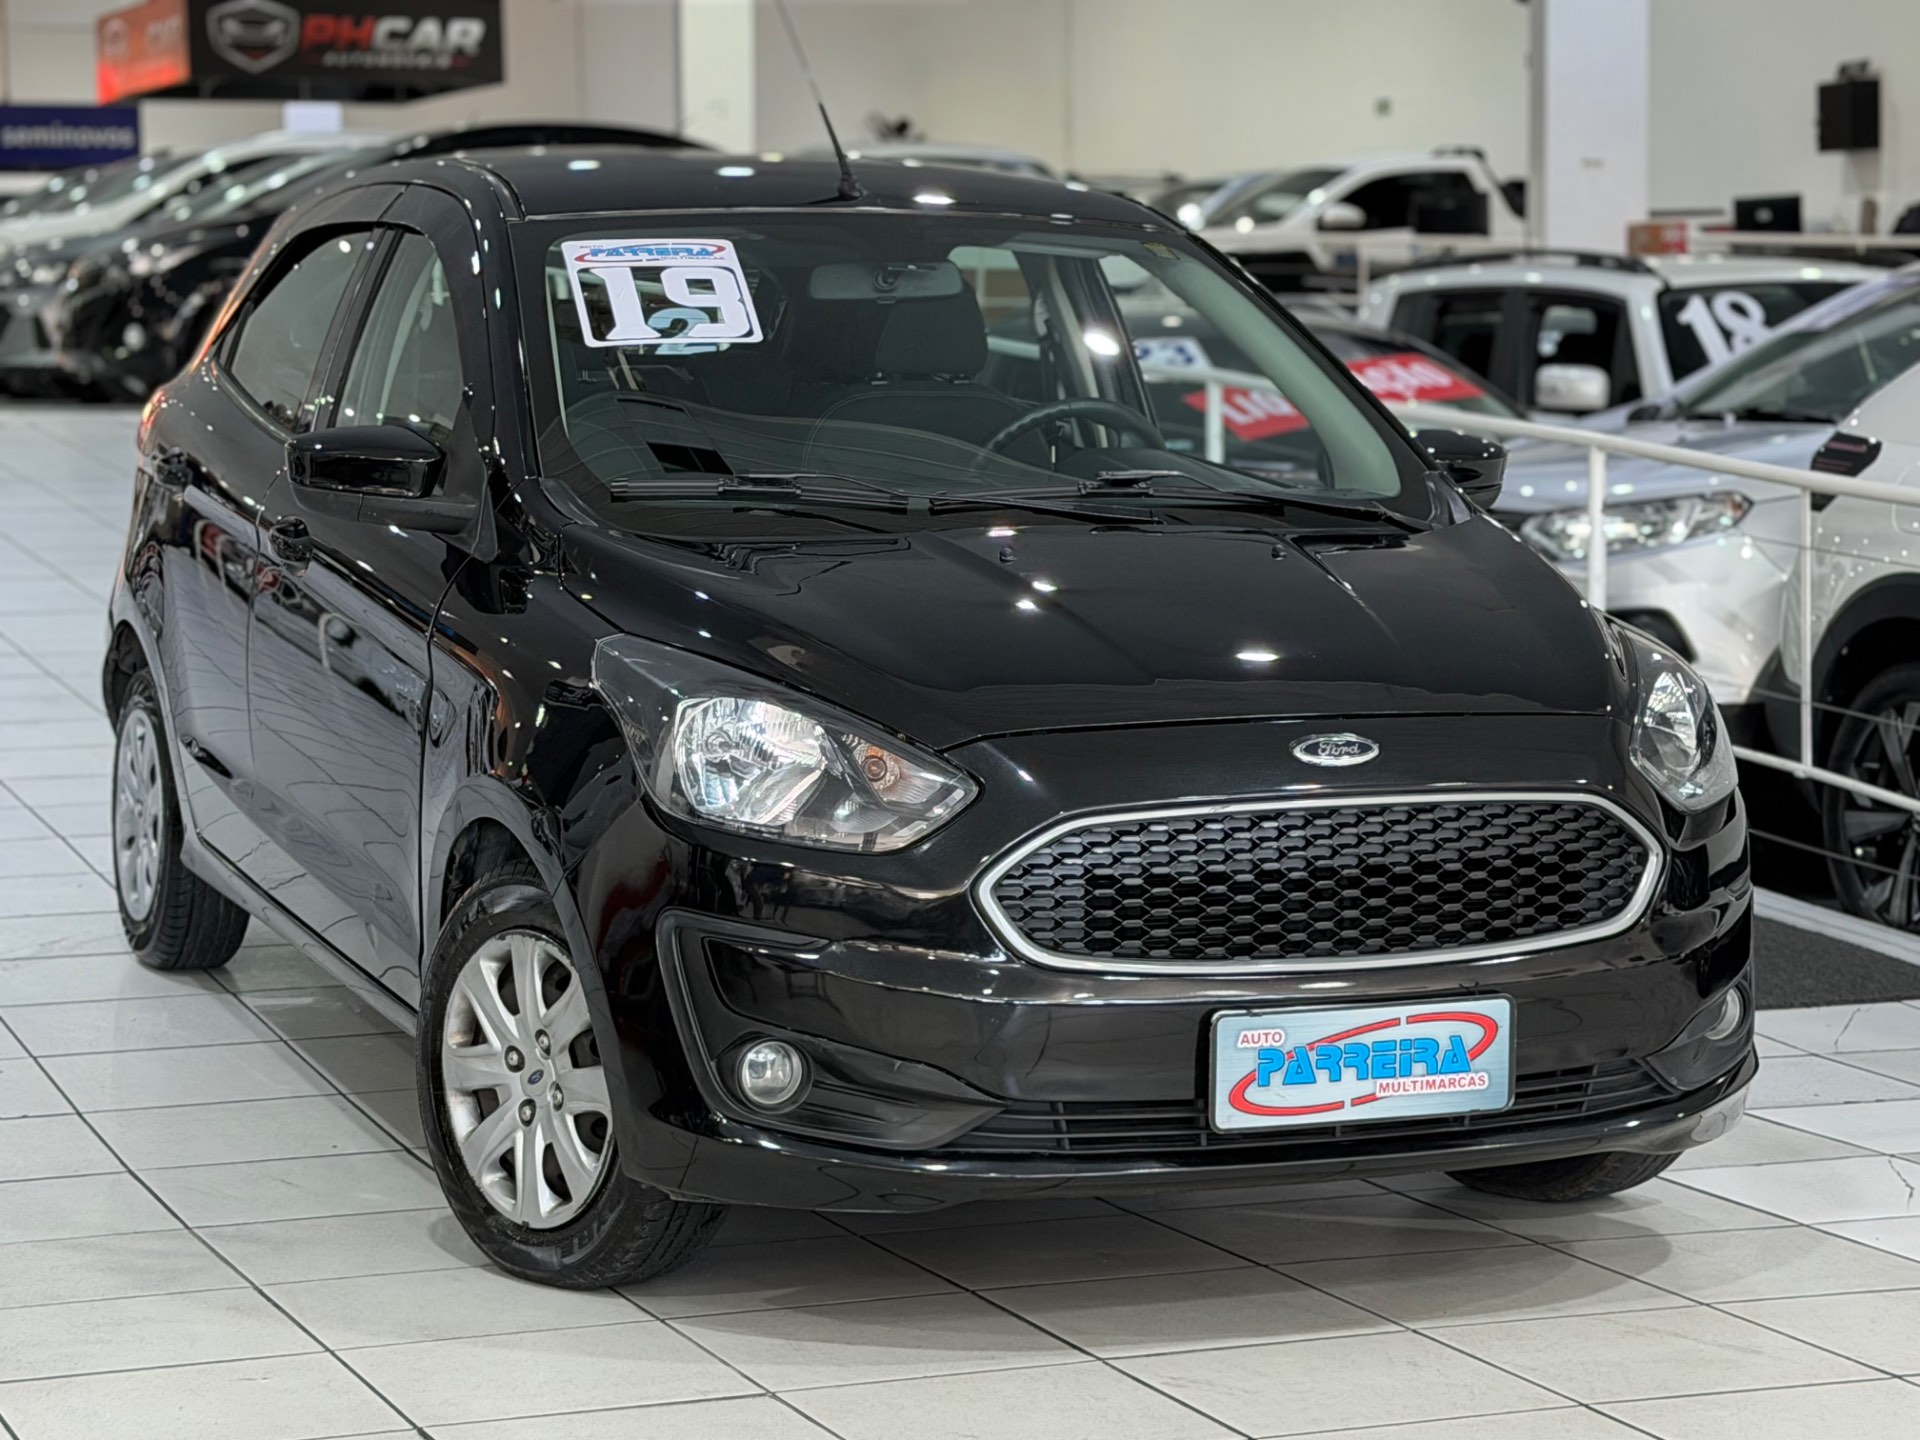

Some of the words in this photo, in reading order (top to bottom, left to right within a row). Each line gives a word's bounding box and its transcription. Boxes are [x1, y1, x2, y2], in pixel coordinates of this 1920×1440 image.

[1, 120, 135, 149] seminovos
[590, 266, 751, 340] 19
[1676, 291, 1772, 365] 18
[1317, 740, 1361, 756] Ford
[1240, 1031, 1283, 1046] AUTO
[1257, 1035, 1471, 1087] PARREIRA
[1378, 1074, 1486, 1095] MULTIMARCAS
